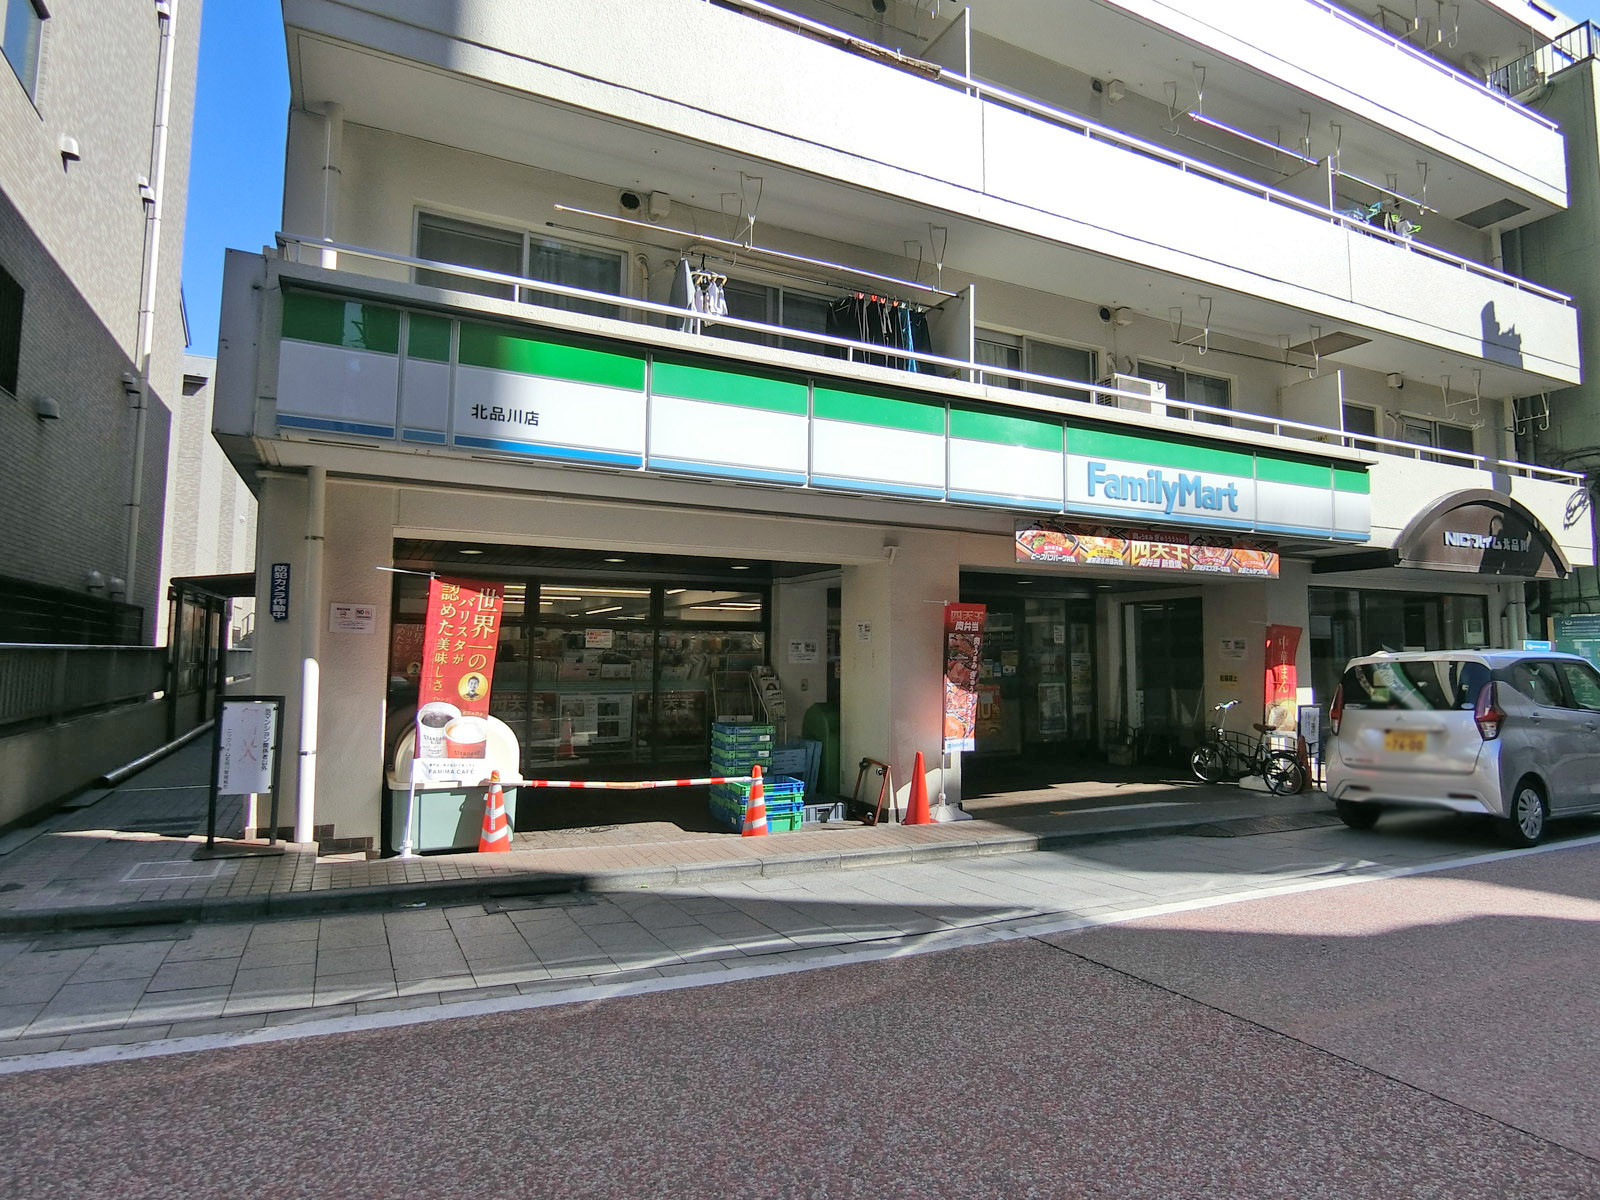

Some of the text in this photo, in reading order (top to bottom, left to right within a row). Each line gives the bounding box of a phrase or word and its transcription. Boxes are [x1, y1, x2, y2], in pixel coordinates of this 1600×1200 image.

[471, 403, 540, 426] 北品川店
[1087, 461, 1238, 514] FamilyMart
[1131, 540, 1188, 570] 四天王
[273, 565, 288, 618] 防犯カメラ作動中
[433, 583, 461, 691] 認めた美味しさ
[452, 597, 476, 665] バリスタが
[467, 588, 501, 670] 世界一の
[955, 621, 979, 631] 肉弁当
[1278, 635, 1290, 693] 中華まん
